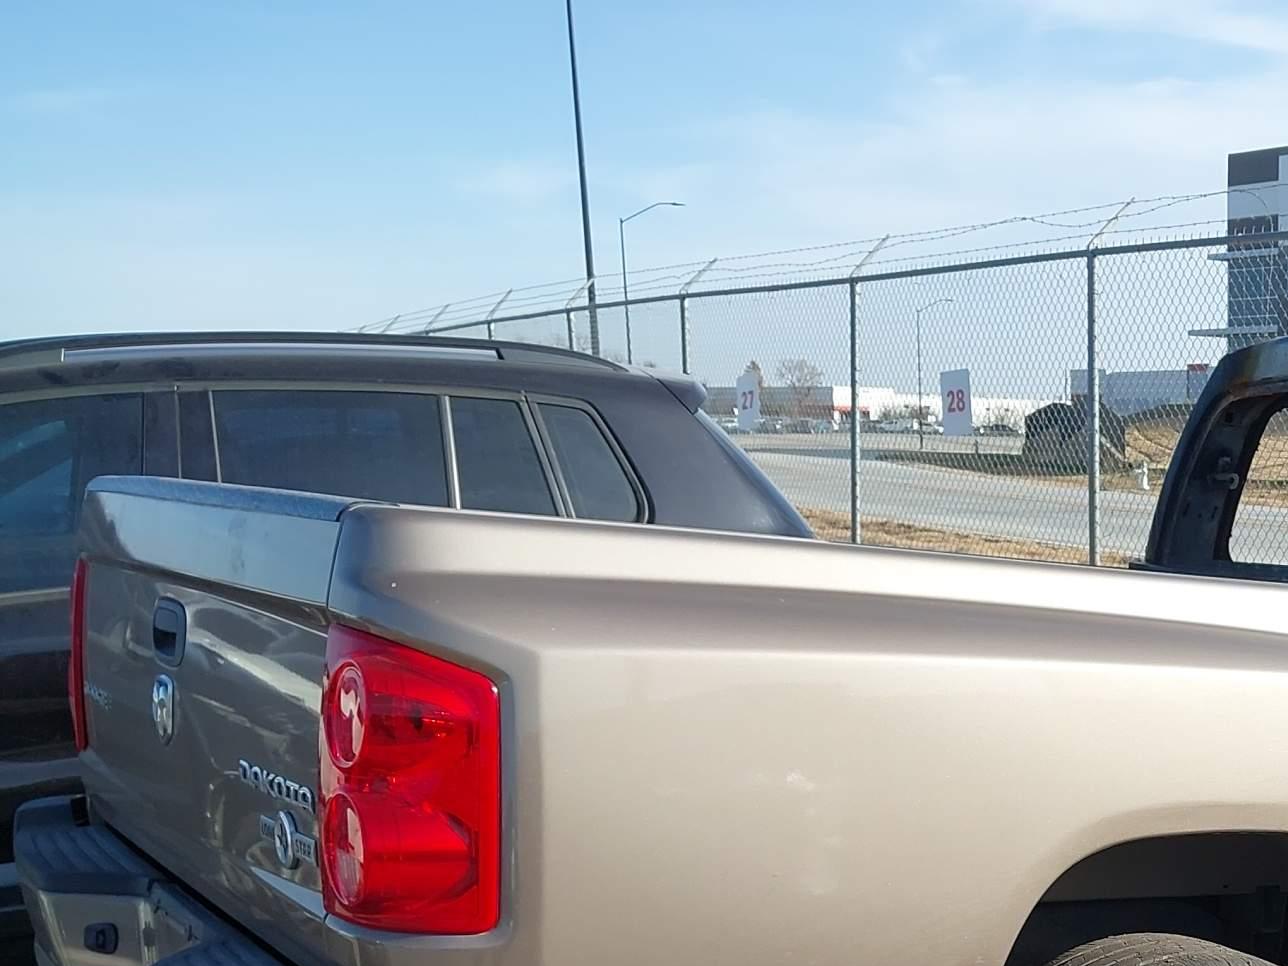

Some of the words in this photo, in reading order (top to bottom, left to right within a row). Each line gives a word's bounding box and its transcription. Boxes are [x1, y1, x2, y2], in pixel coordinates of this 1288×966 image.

[741, 390, 754, 410] 27
[946, 389, 965, 412] 28
[239, 759, 315, 815] DAKOTA
